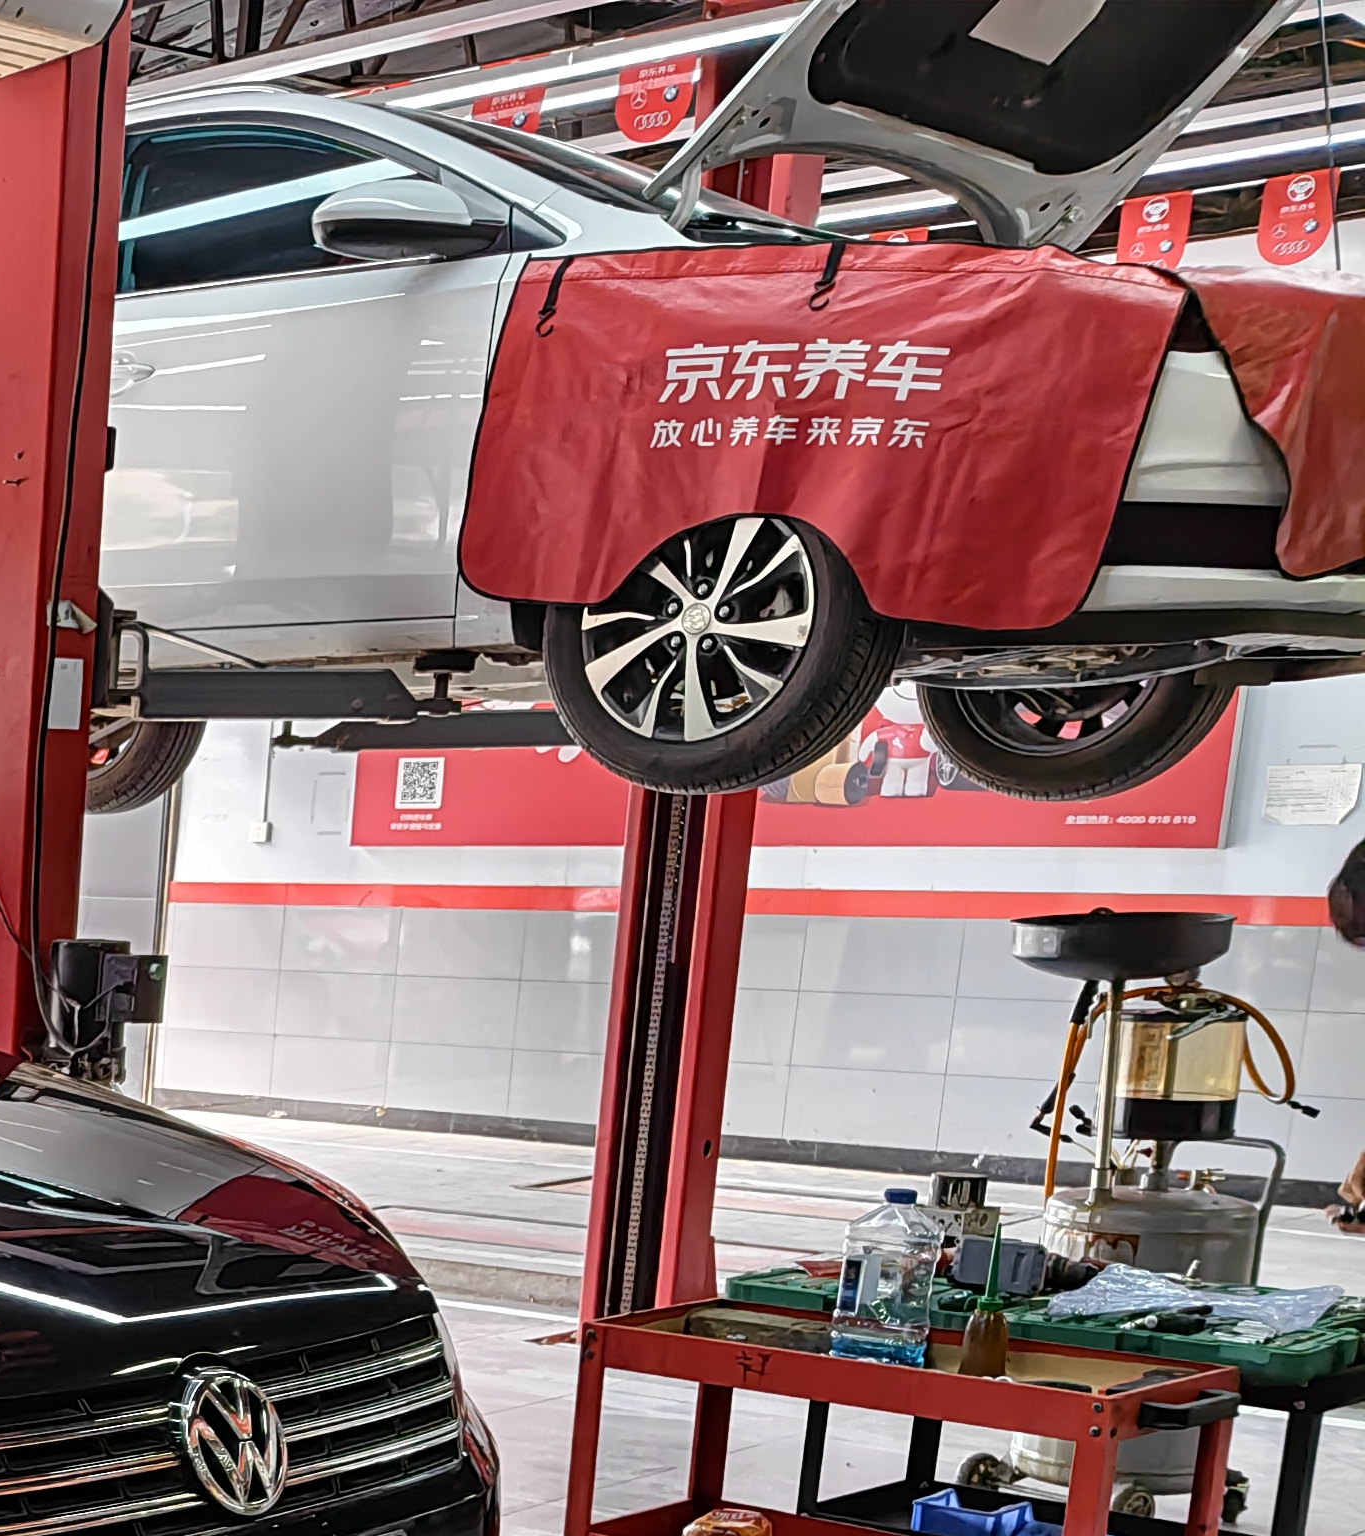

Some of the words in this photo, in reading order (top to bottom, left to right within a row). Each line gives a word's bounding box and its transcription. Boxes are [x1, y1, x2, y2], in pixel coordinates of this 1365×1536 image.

[658, 338, 951, 403] 京东养车
[650, 415, 931, 449] 放心养车来京东
